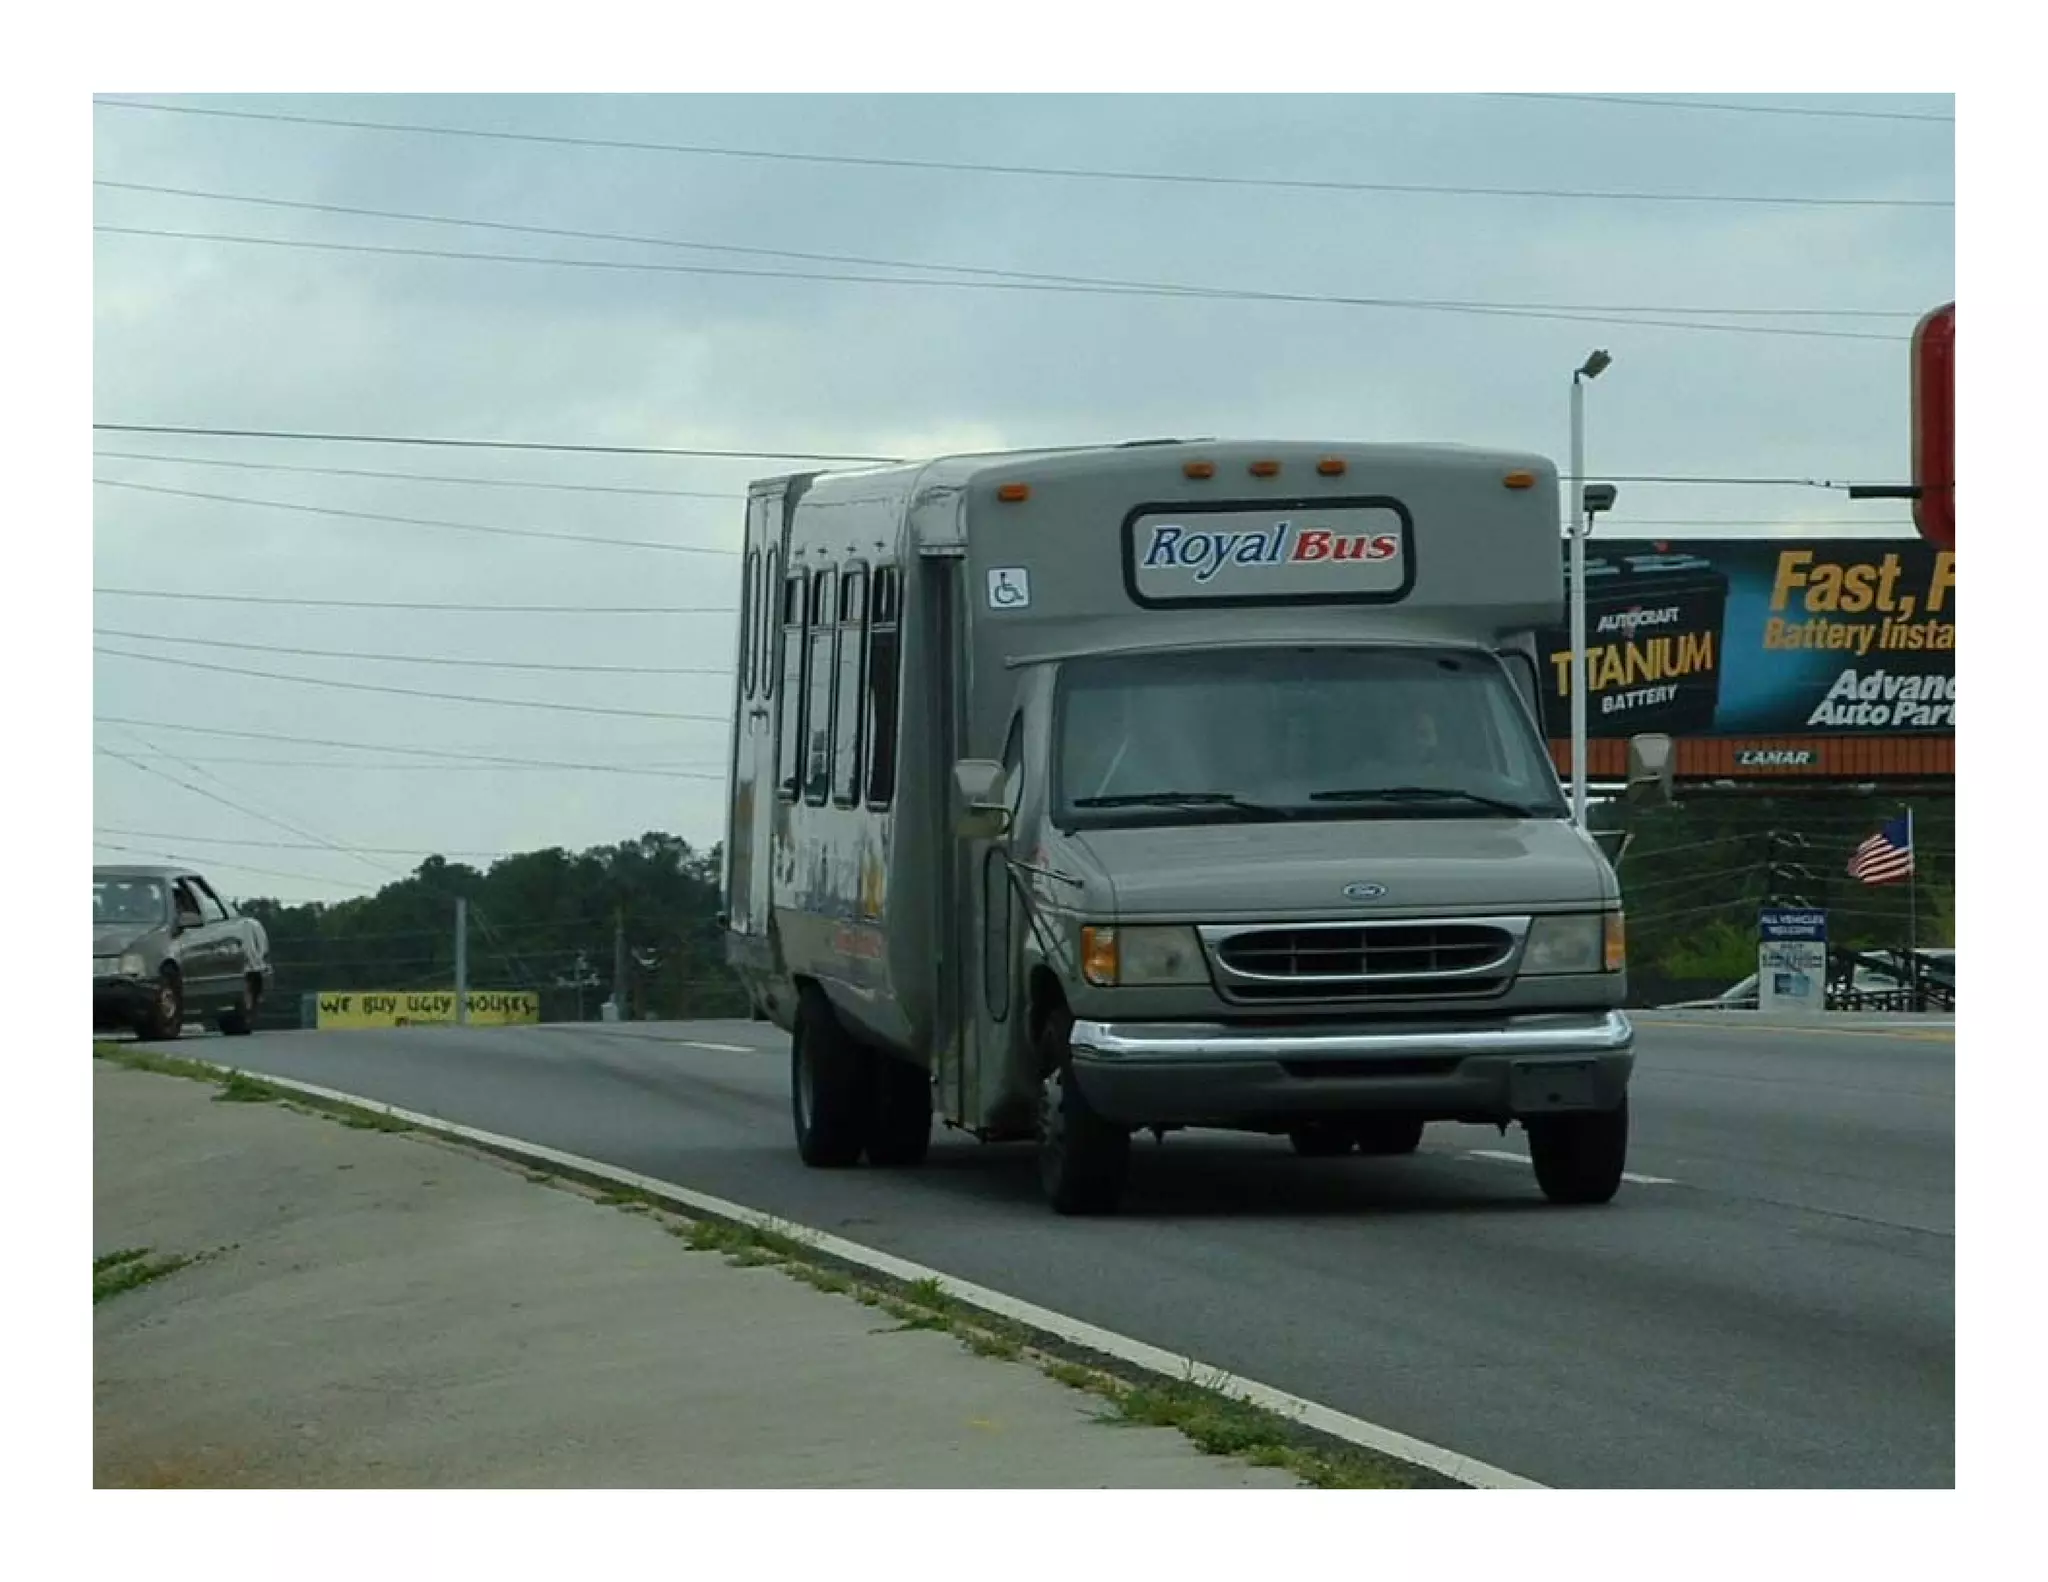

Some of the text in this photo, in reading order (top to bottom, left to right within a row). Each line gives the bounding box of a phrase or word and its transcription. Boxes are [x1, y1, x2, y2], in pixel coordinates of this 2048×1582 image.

[1141, 520, 1398, 583] Royal Bus
[1770, 550, 1915, 621] Fast,
[1763, 618, 1871, 655] Battery
[1550, 631, 1713, 696] TTANIUM
[1601, 684, 1677, 713] BATTERY
[1807, 701, 1889, 726] Auto
[1738, 750, 1811, 766] LAMAR
[362, 995, 396, 1015] BUY
[407, 995, 452, 1014] UGLY
